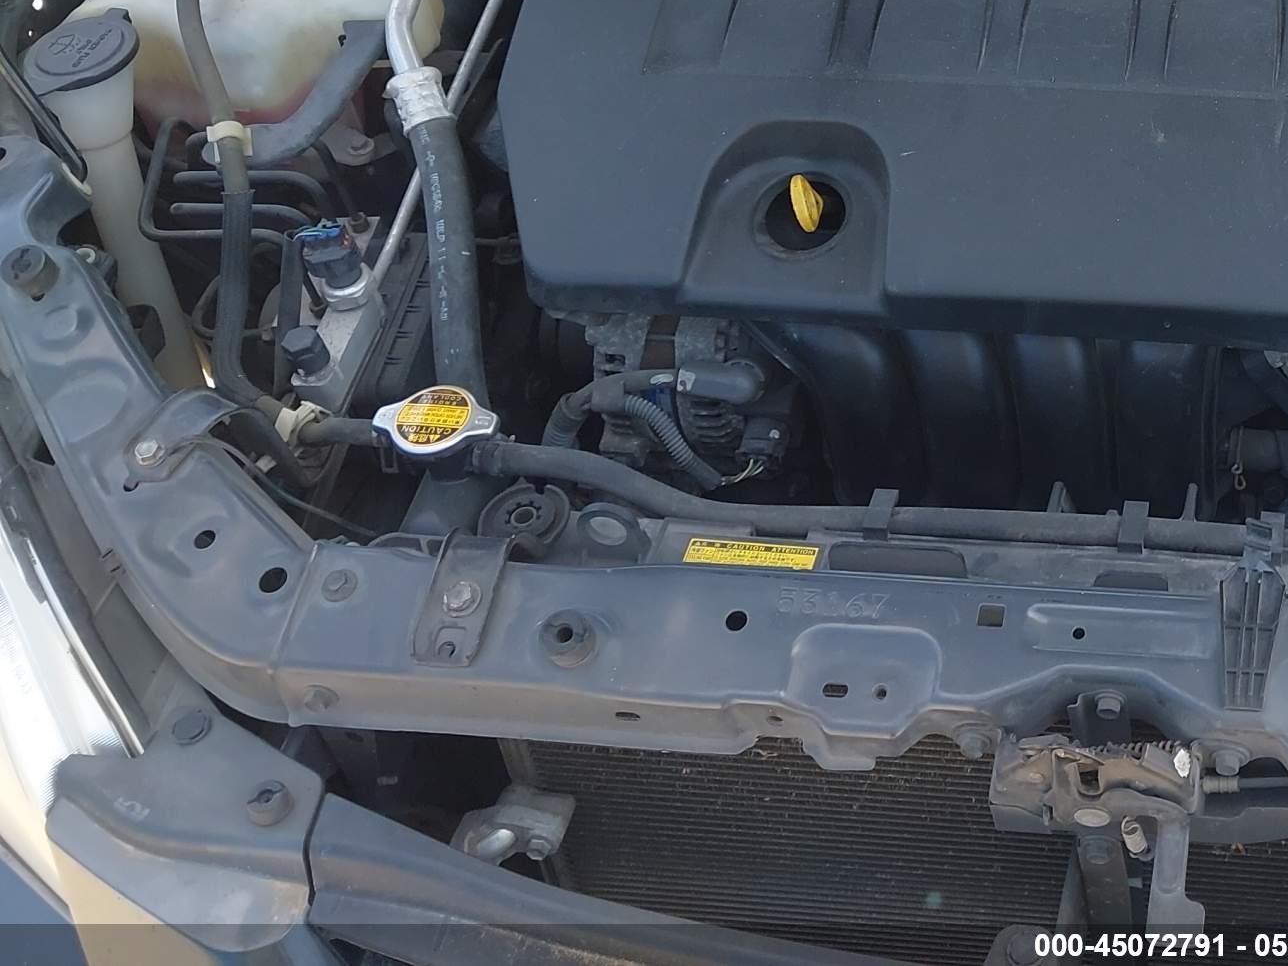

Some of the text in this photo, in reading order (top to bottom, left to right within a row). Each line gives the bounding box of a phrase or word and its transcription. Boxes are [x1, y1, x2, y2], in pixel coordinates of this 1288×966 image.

[400, 425, 452, 434] CAUTION
[727, 543, 765, 552] CAUTION
[771, 546, 814, 555] ATTENTION
